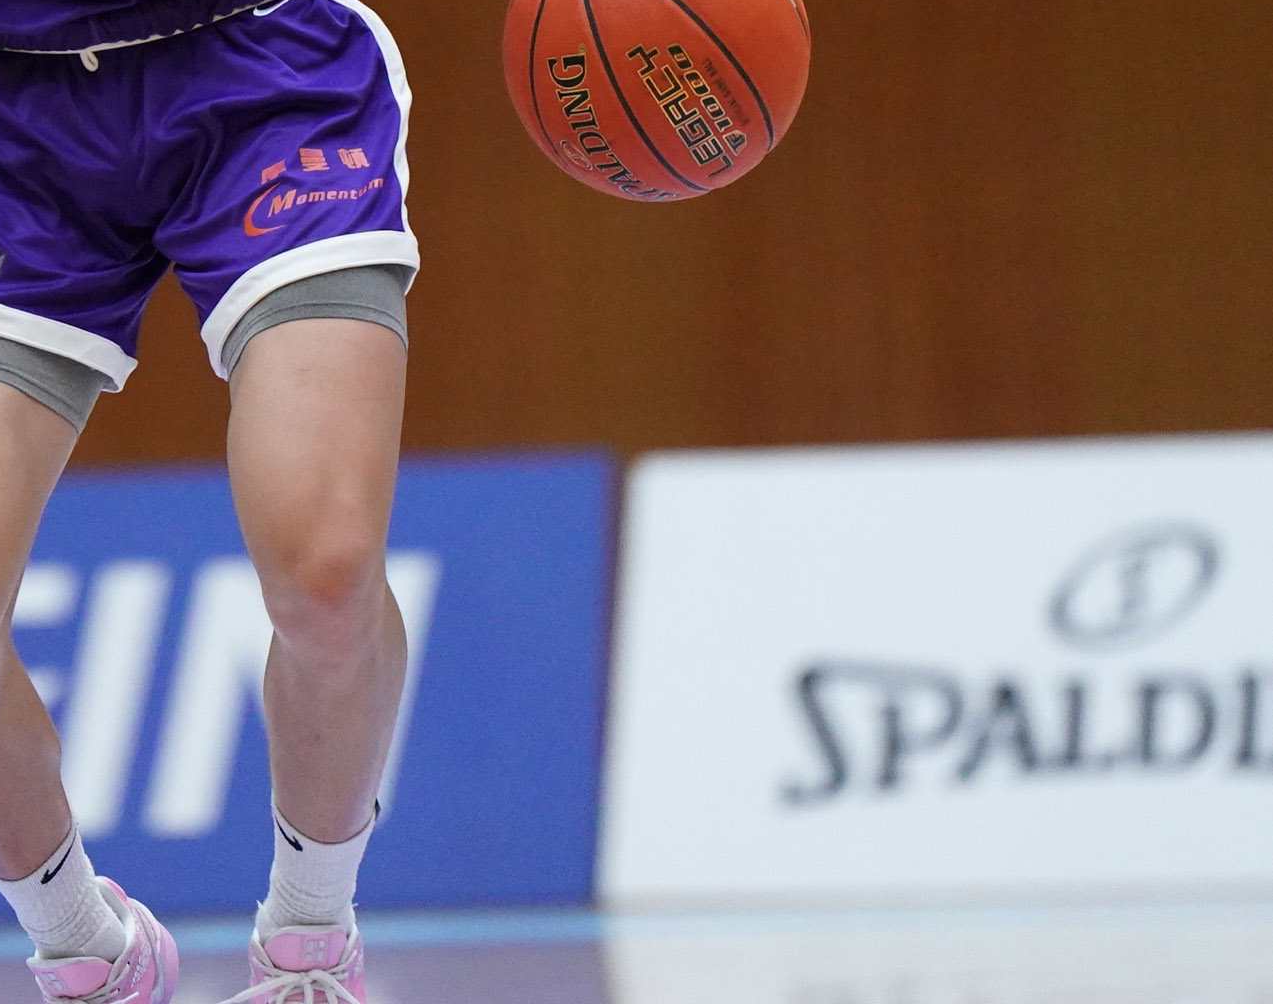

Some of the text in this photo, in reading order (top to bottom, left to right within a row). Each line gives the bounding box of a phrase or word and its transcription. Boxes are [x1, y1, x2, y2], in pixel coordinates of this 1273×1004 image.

[546, 53, 678, 199] SPALDING
[626, 44, 733, 179] LEGACY
[667, 43, 732, 133] 1000
[267, 178, 384, 218] Momentum
[778, 656, 1273, 804] SPALDI
